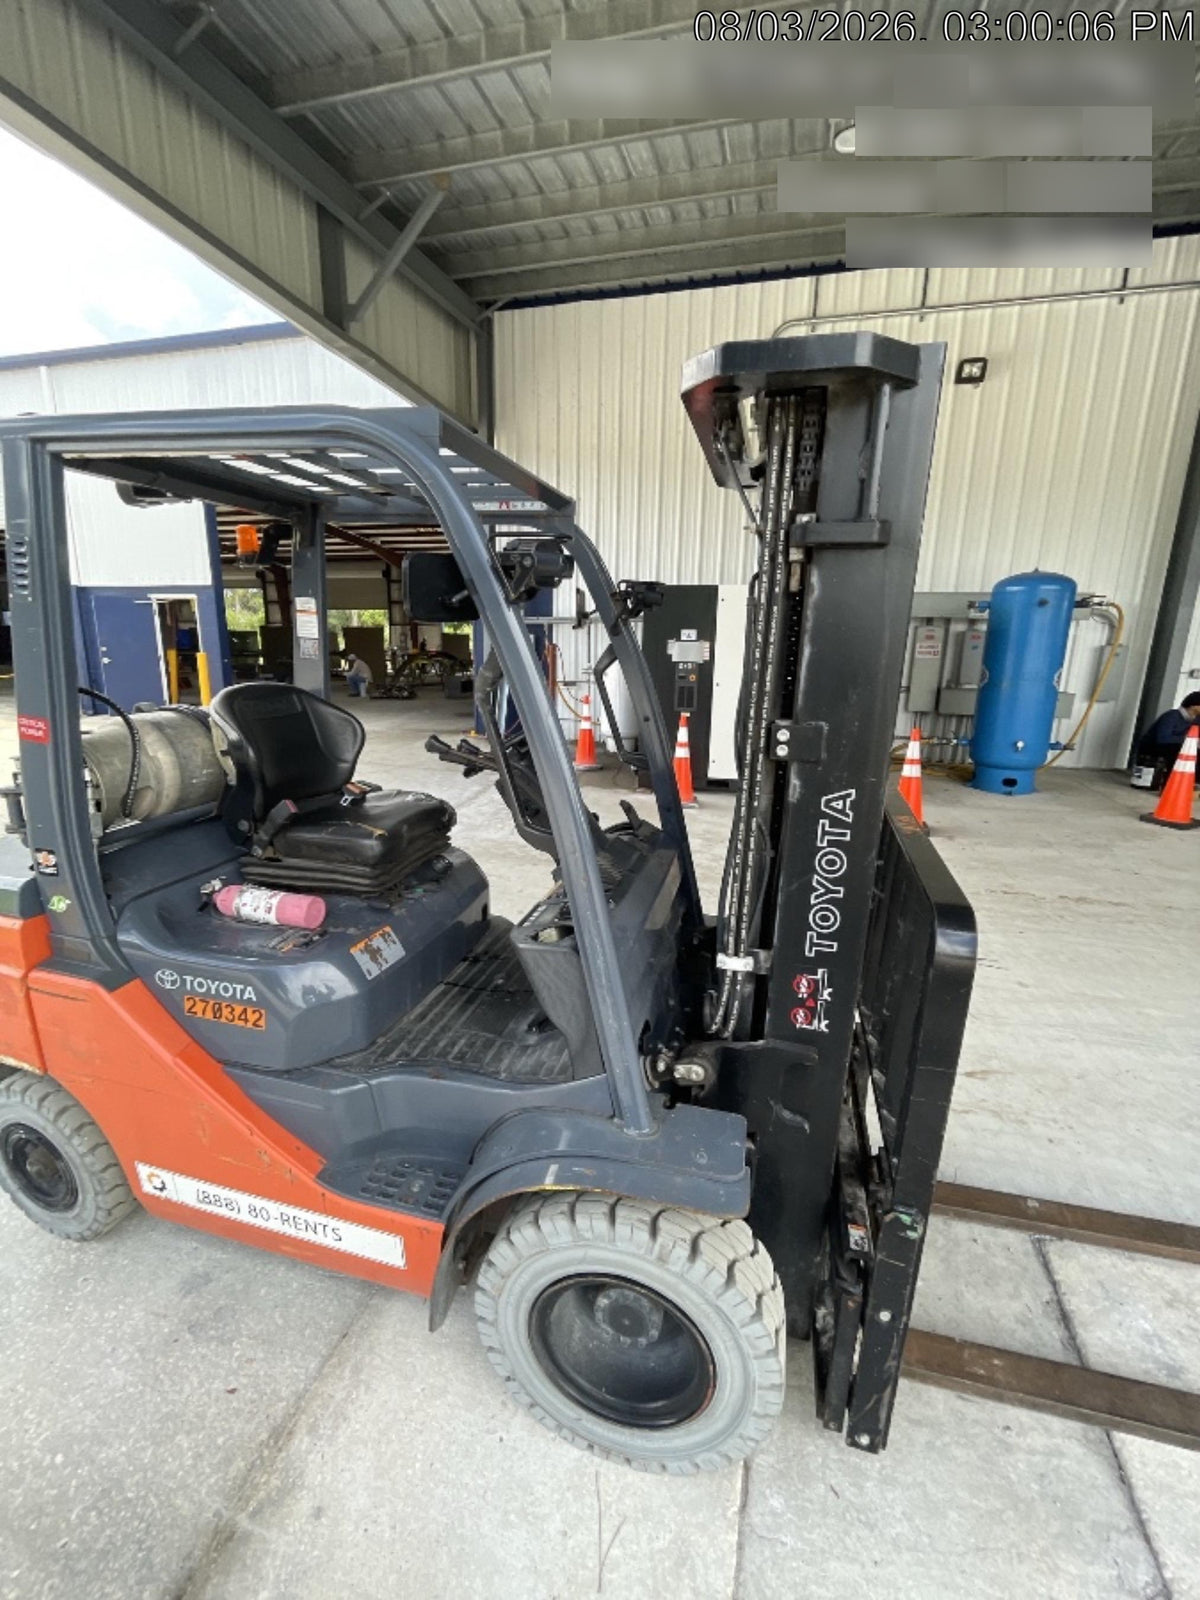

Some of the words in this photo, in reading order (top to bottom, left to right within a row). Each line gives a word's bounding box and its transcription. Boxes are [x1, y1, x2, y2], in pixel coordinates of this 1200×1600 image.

[804, 787, 857, 957] TOYOTA
[182, 974, 257, 1002] TOYOTA
[185, 996, 265, 1029] 270342
[195, 1188, 241, 1215] (888)
[247, 1203, 343, 1242] 80-RENTS
